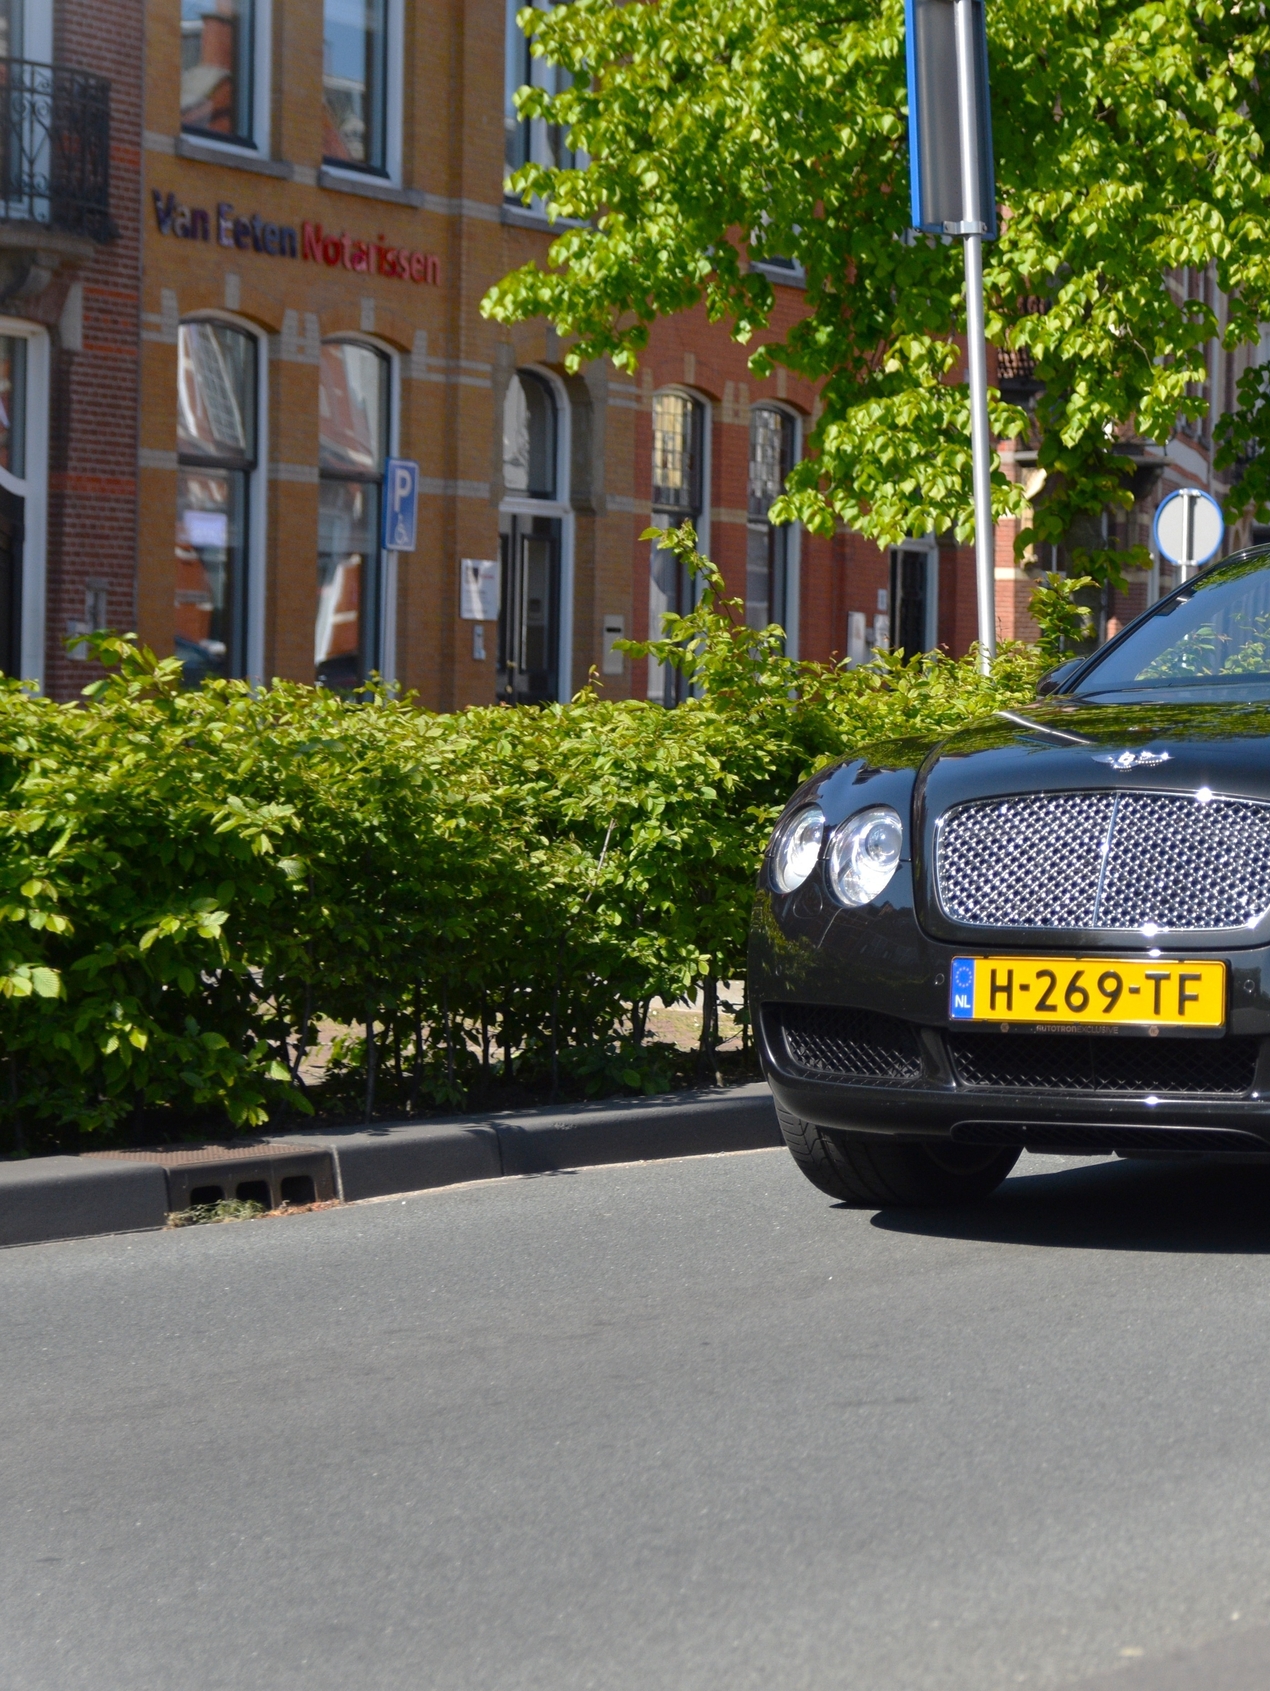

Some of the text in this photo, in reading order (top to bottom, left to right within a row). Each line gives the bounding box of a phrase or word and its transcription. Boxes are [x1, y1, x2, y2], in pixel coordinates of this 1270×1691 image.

[152, 189, 441, 286] Van Eeten Notarissen
[393, 467, 413, 512] P
[954, 995, 971, 1009] NL
[989, 969, 1202, 1016] H-269-TF
